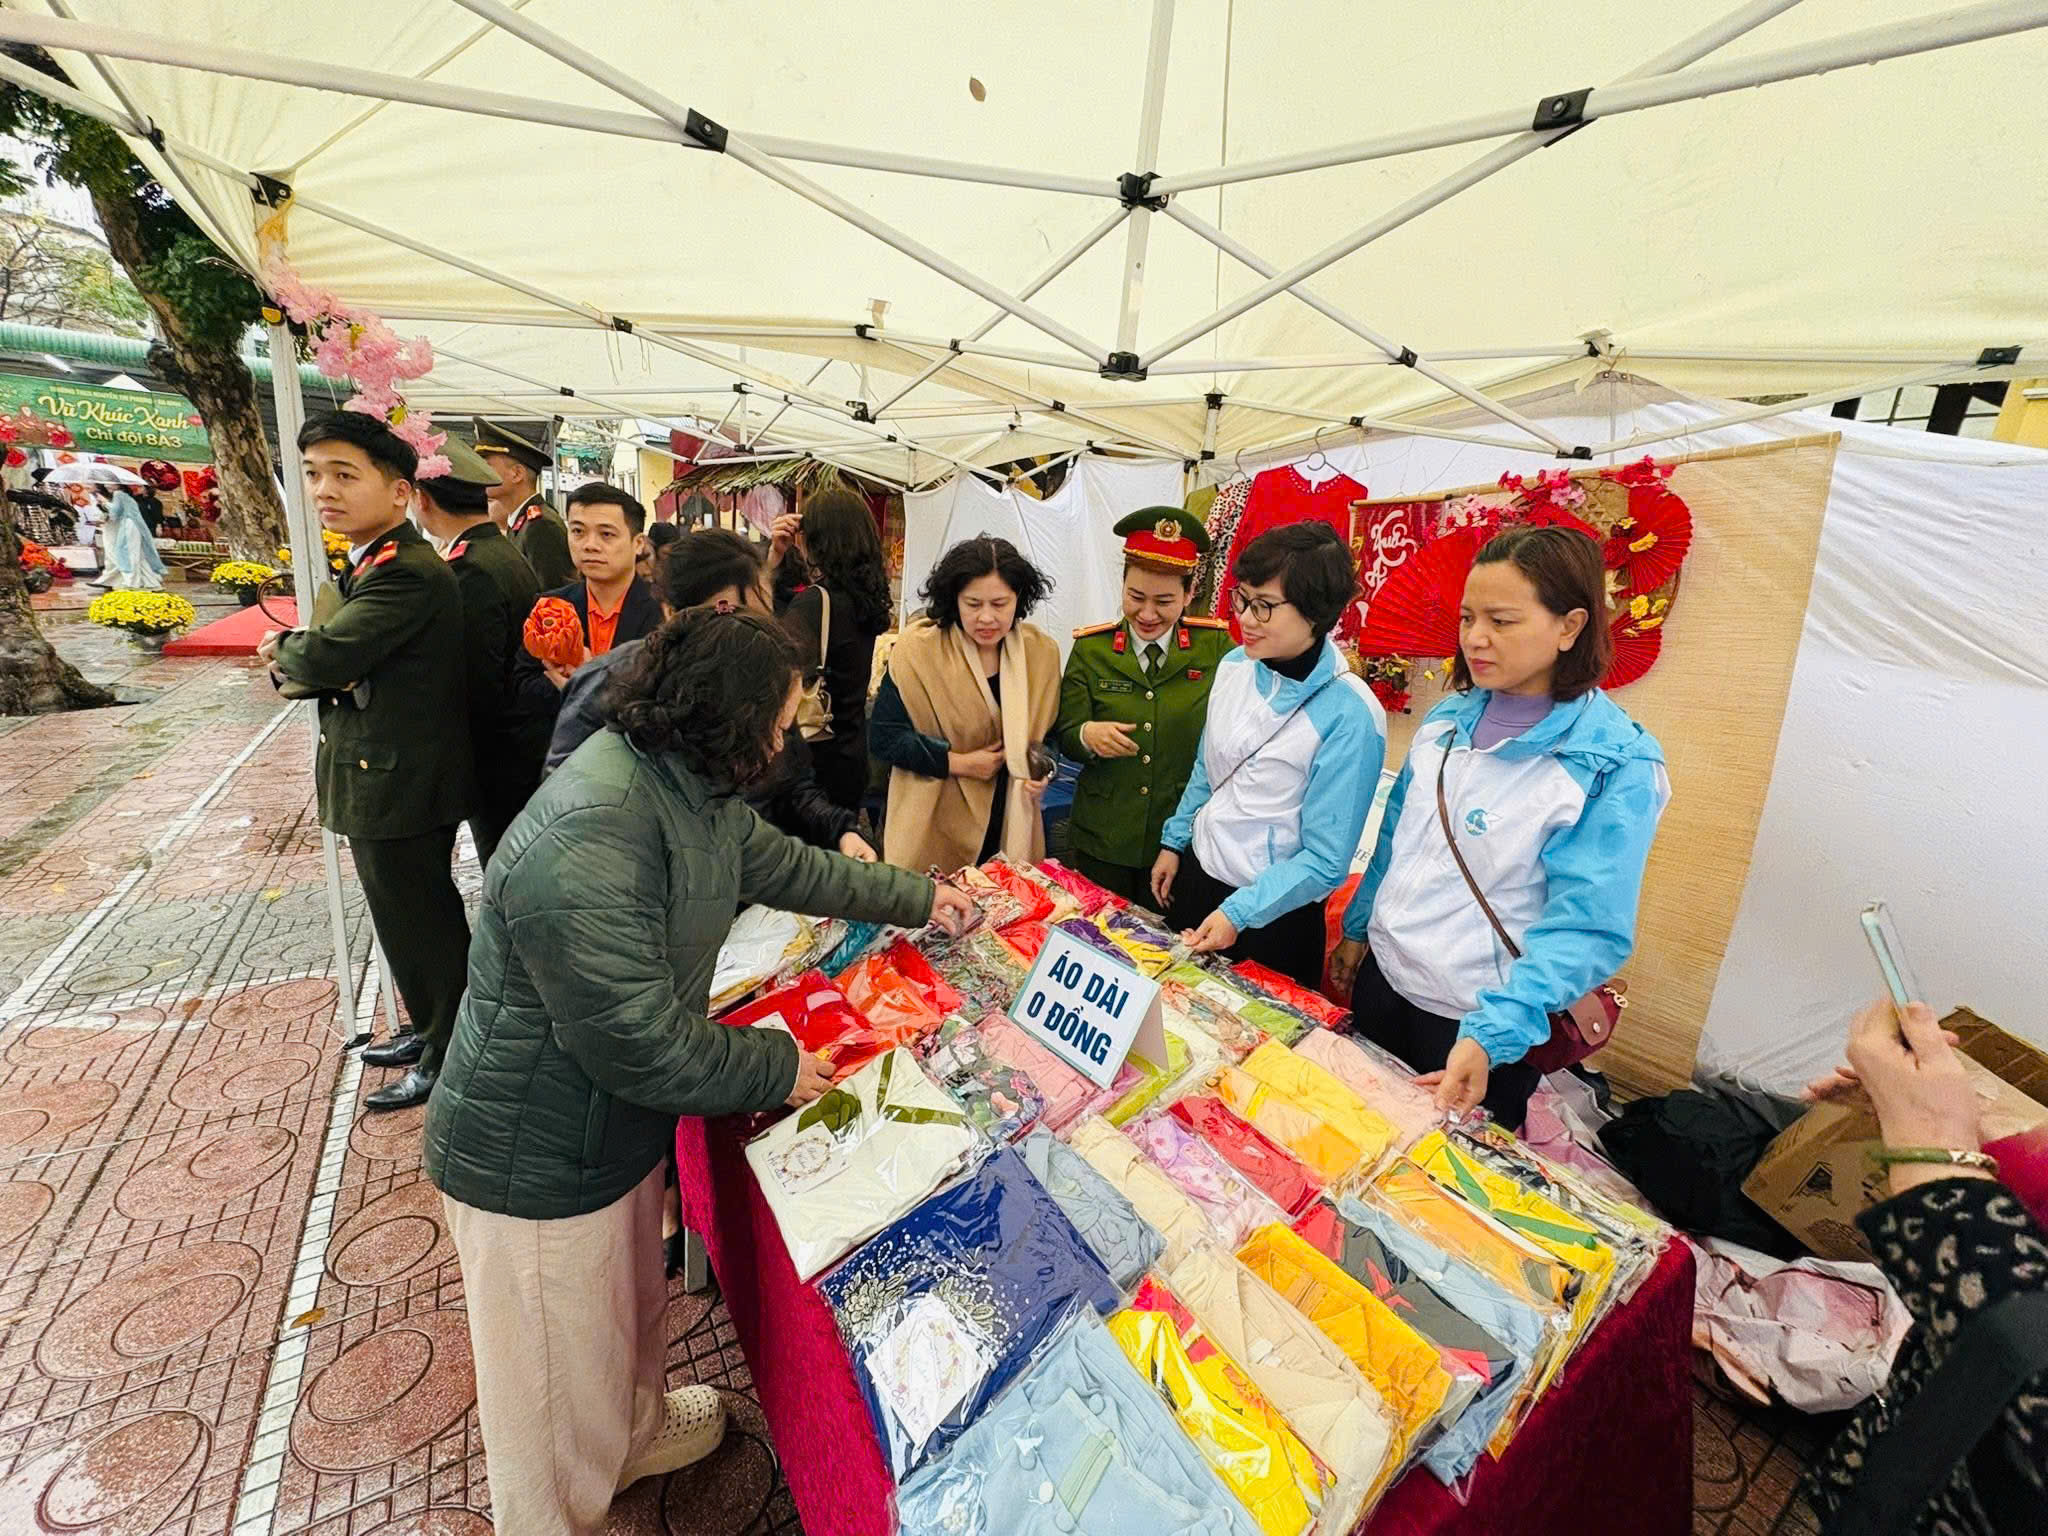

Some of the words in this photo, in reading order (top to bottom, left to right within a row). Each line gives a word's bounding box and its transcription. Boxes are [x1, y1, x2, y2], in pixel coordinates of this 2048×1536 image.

[78, 400, 135, 427] Khúc
[134, 406, 190, 432] Xanh
[86, 427, 114, 441] Chi
[116, 430, 143, 446] đội
[145, 433, 184, 448] 8A3
[1047, 950, 1084, 990] ÁO
[1082, 973, 1130, 1019] DÀI
[1043, 1001, 1112, 1065] ĐỒNG
